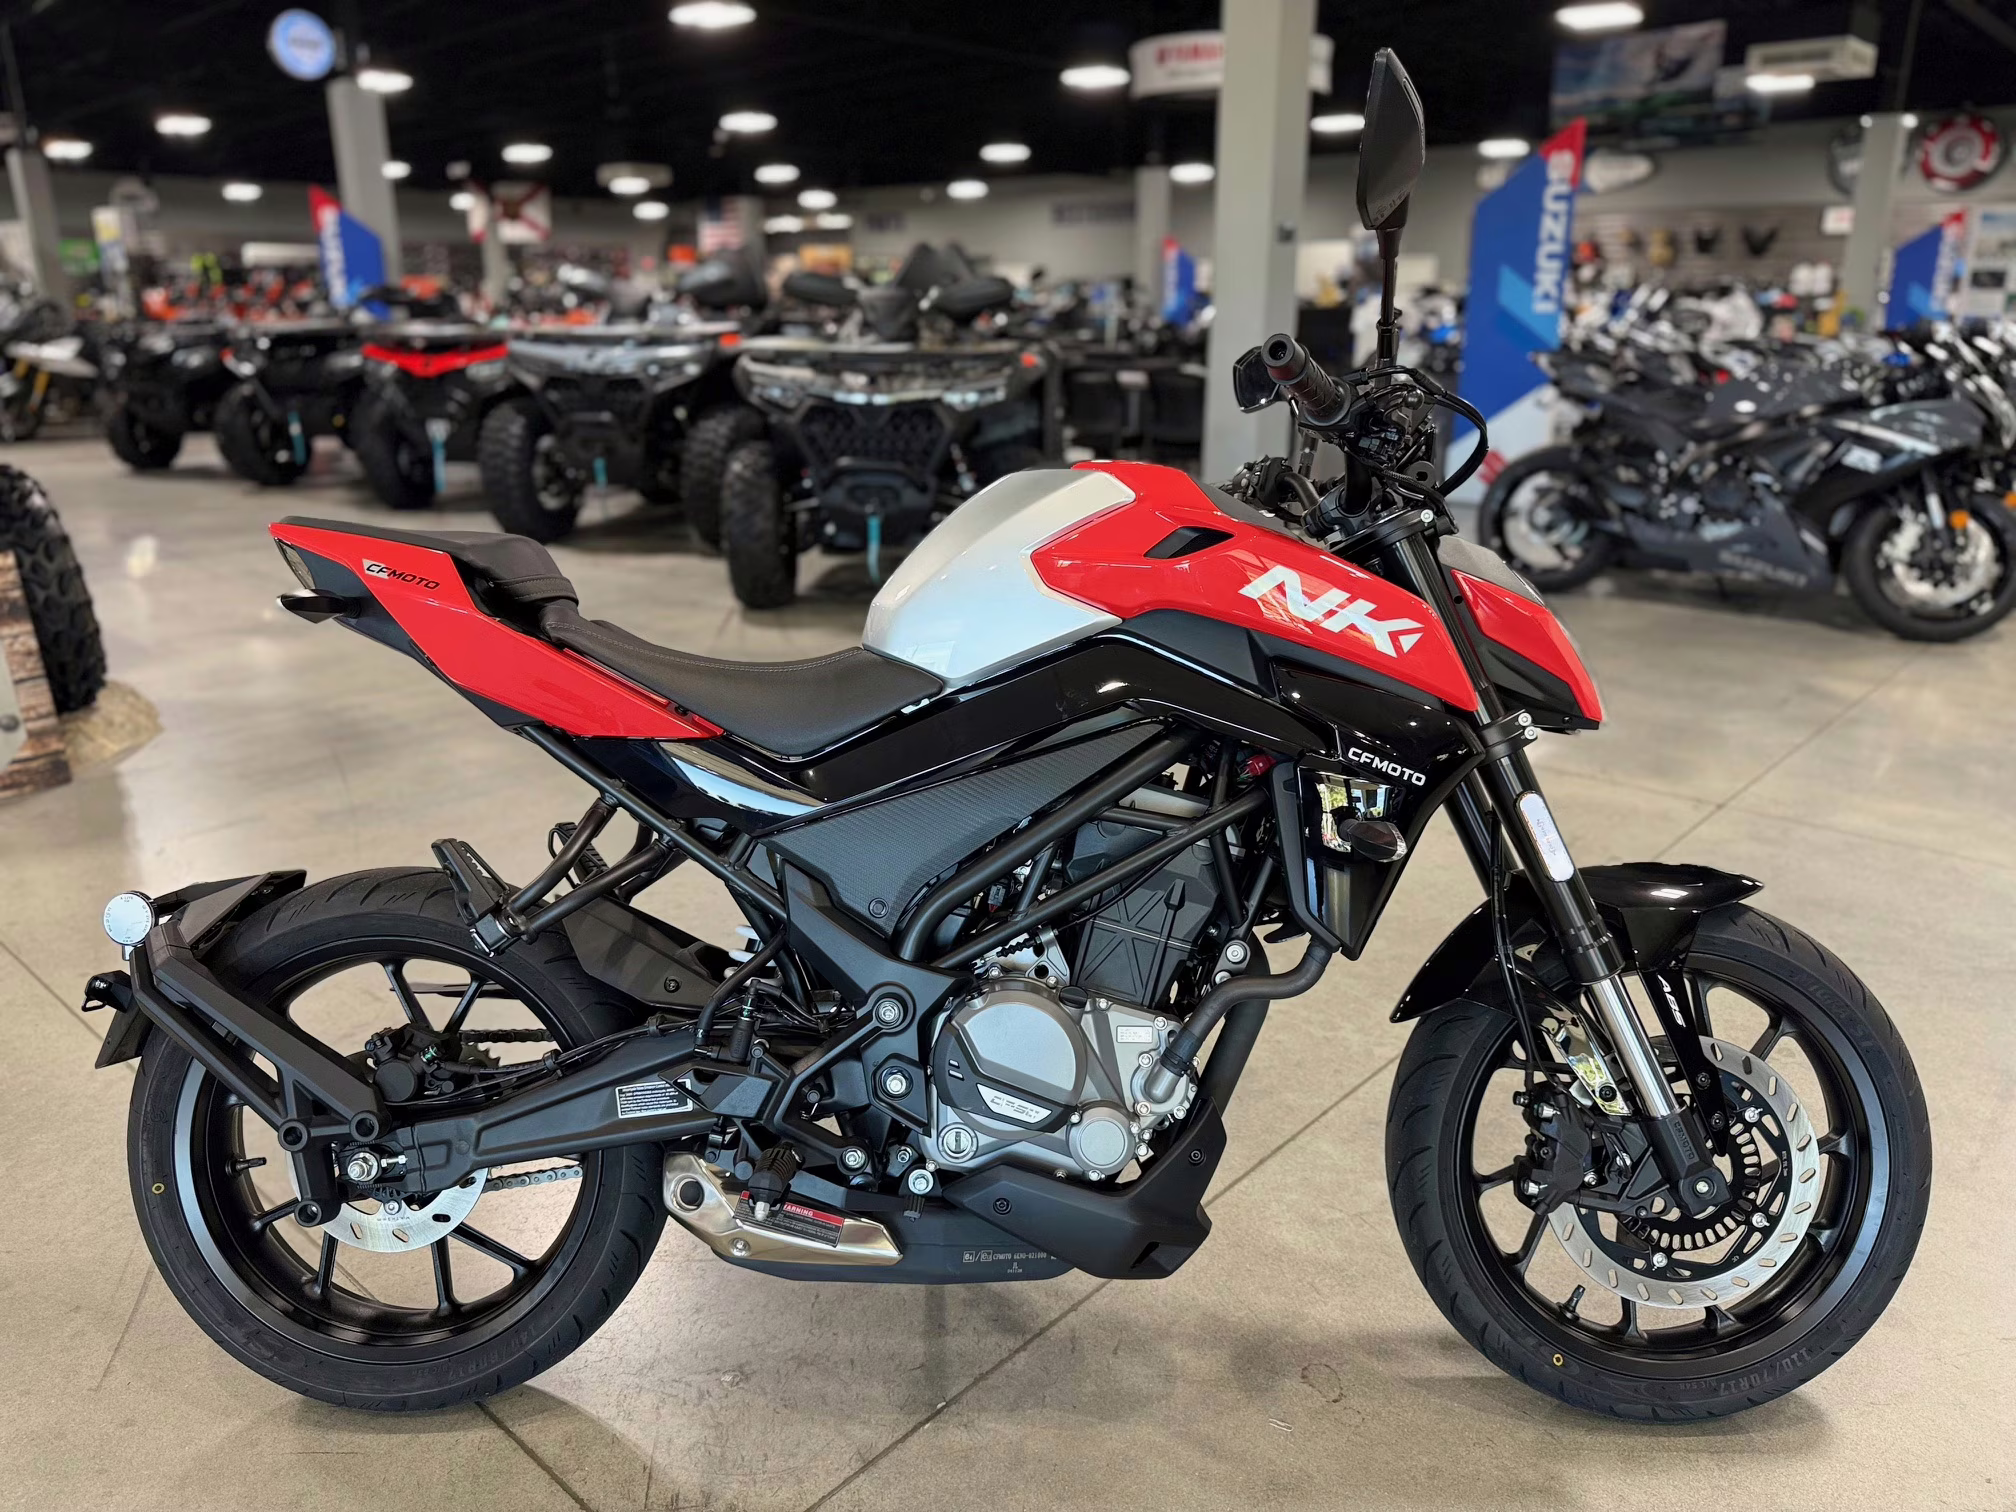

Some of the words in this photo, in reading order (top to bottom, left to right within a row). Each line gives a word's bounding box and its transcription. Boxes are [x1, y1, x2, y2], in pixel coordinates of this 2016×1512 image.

[1533, 150, 1574, 313] SUZUKI
[366, 563, 440, 589] CFMOTO
[1238, 564, 1425, 658] NK
[1348, 747, 1426, 786] CFMOTO
[1657, 974, 1686, 1027] ABS
[1674, 1120, 1695, 1160] CFMOTO
[1720, 1347, 1812, 1396] 110/70R17
